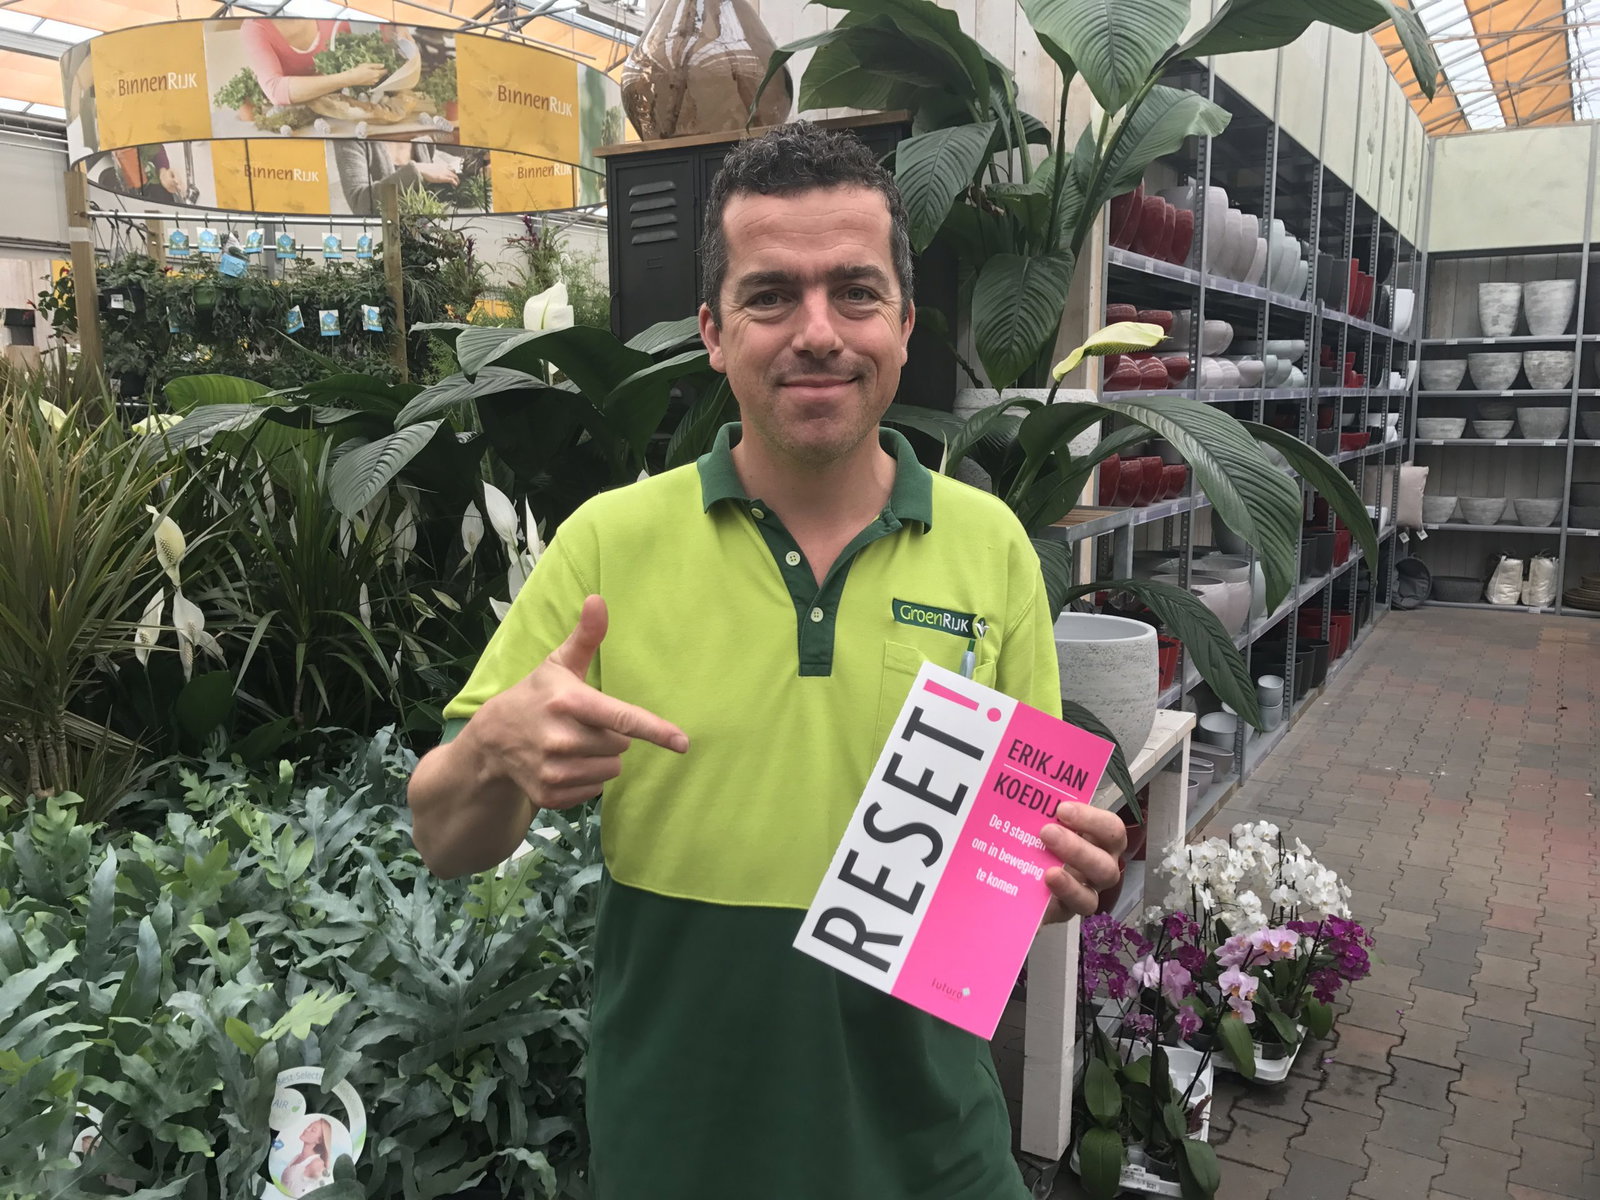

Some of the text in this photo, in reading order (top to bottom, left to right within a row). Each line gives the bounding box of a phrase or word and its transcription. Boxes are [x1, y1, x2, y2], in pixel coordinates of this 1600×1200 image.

[1007, 738, 1089, 792] ERIK JAN
[993, 772, 1062, 821] KOEDIJ
[811, 678, 1002, 974] RESET!
[989, 813, 1046, 851] De 9 stappen
[971, 837, 1044, 881] om in beweging
[976, 867, 1019, 896] te komen
[295, 1070, 321, 1081] Selecti
